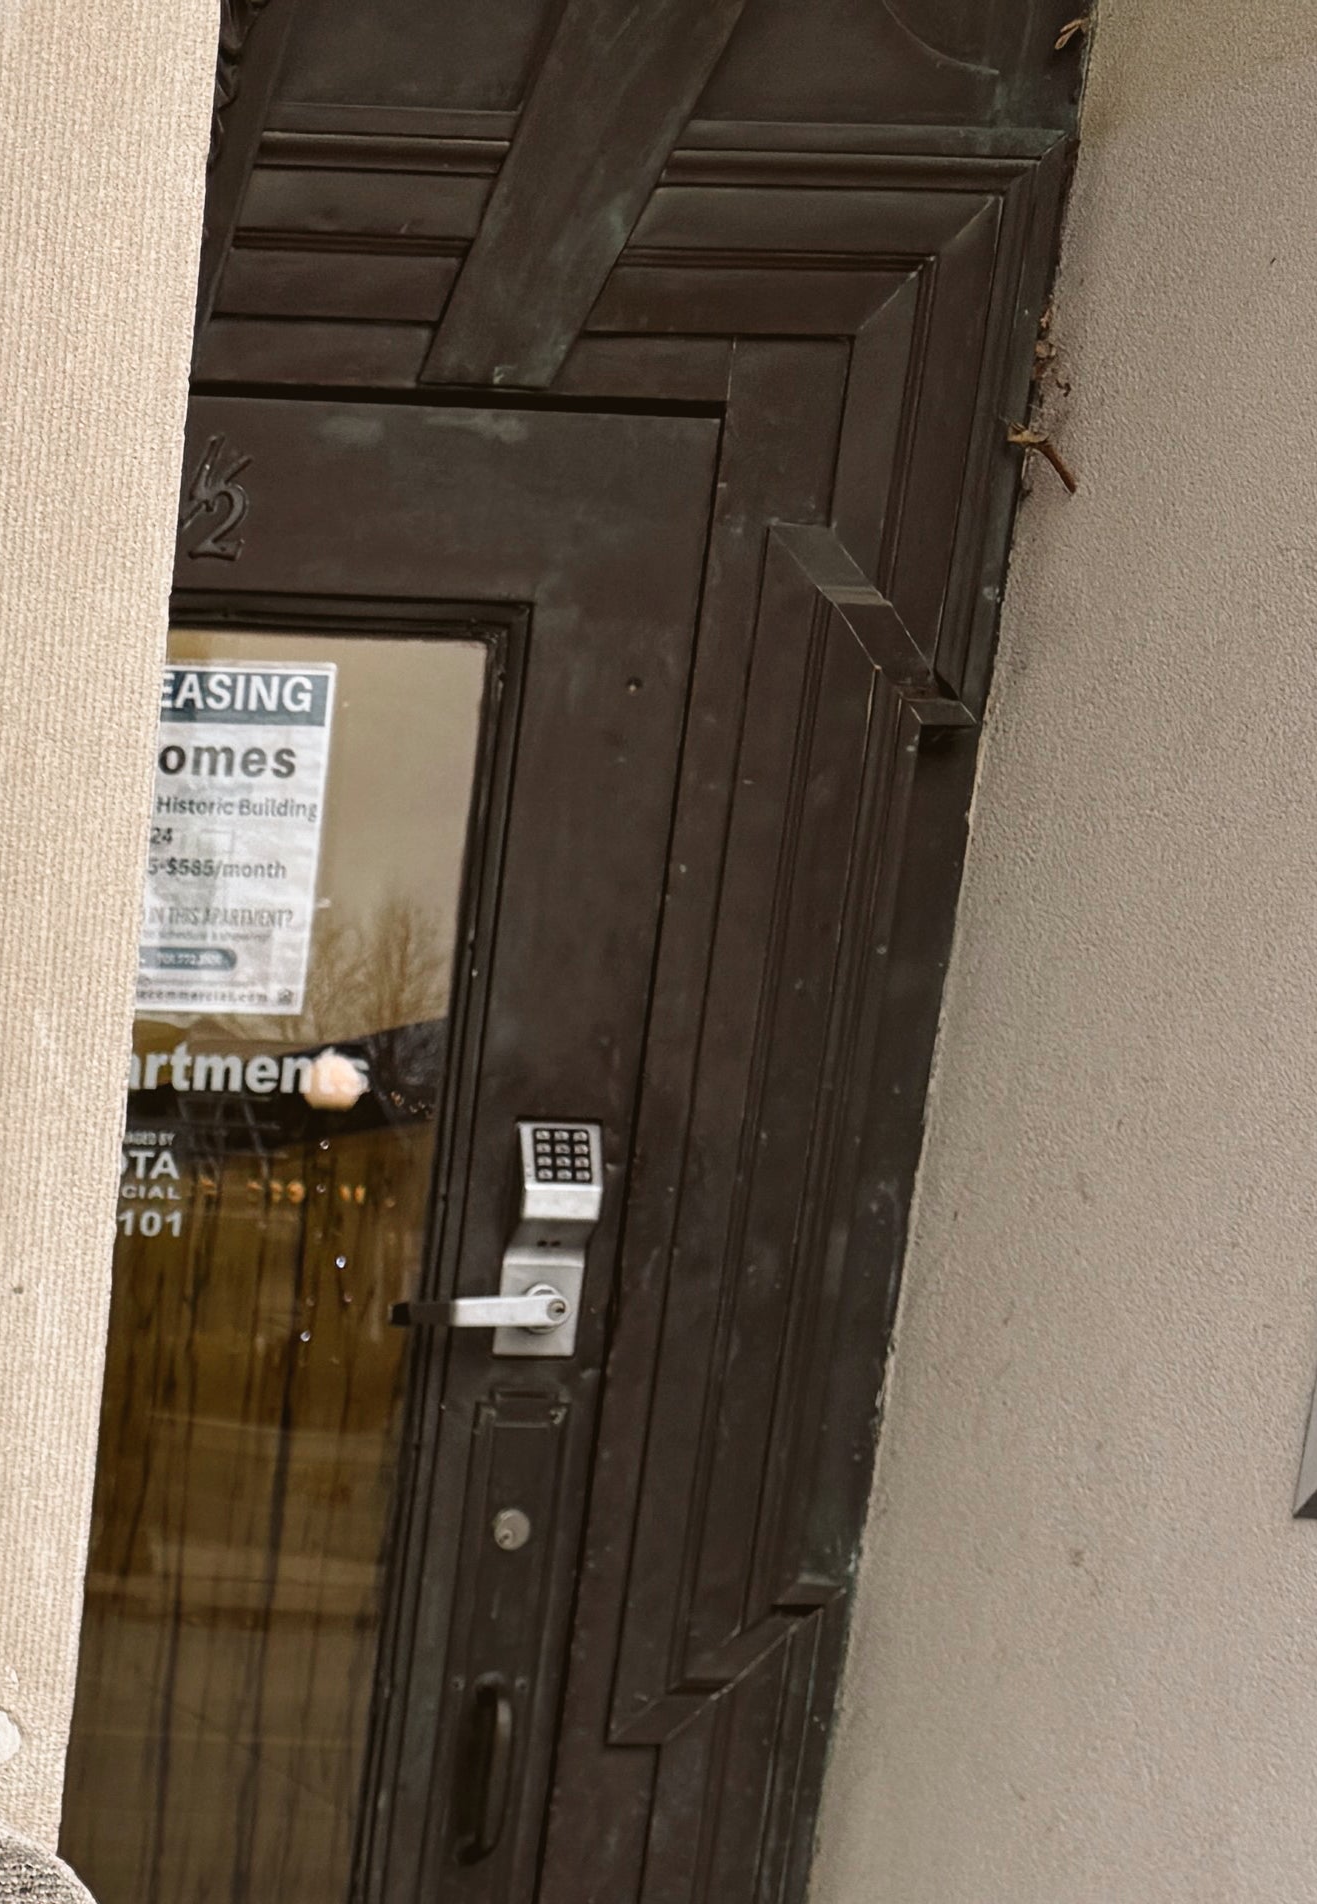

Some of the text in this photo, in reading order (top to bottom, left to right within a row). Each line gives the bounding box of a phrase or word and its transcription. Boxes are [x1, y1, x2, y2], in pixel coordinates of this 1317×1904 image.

[158, 744, 297, 779] omes
[156, 796, 318, 823] Historic Building
[121, 1183, 182, 1200] CIAL
[117, 1209, 183, 1238] 101
